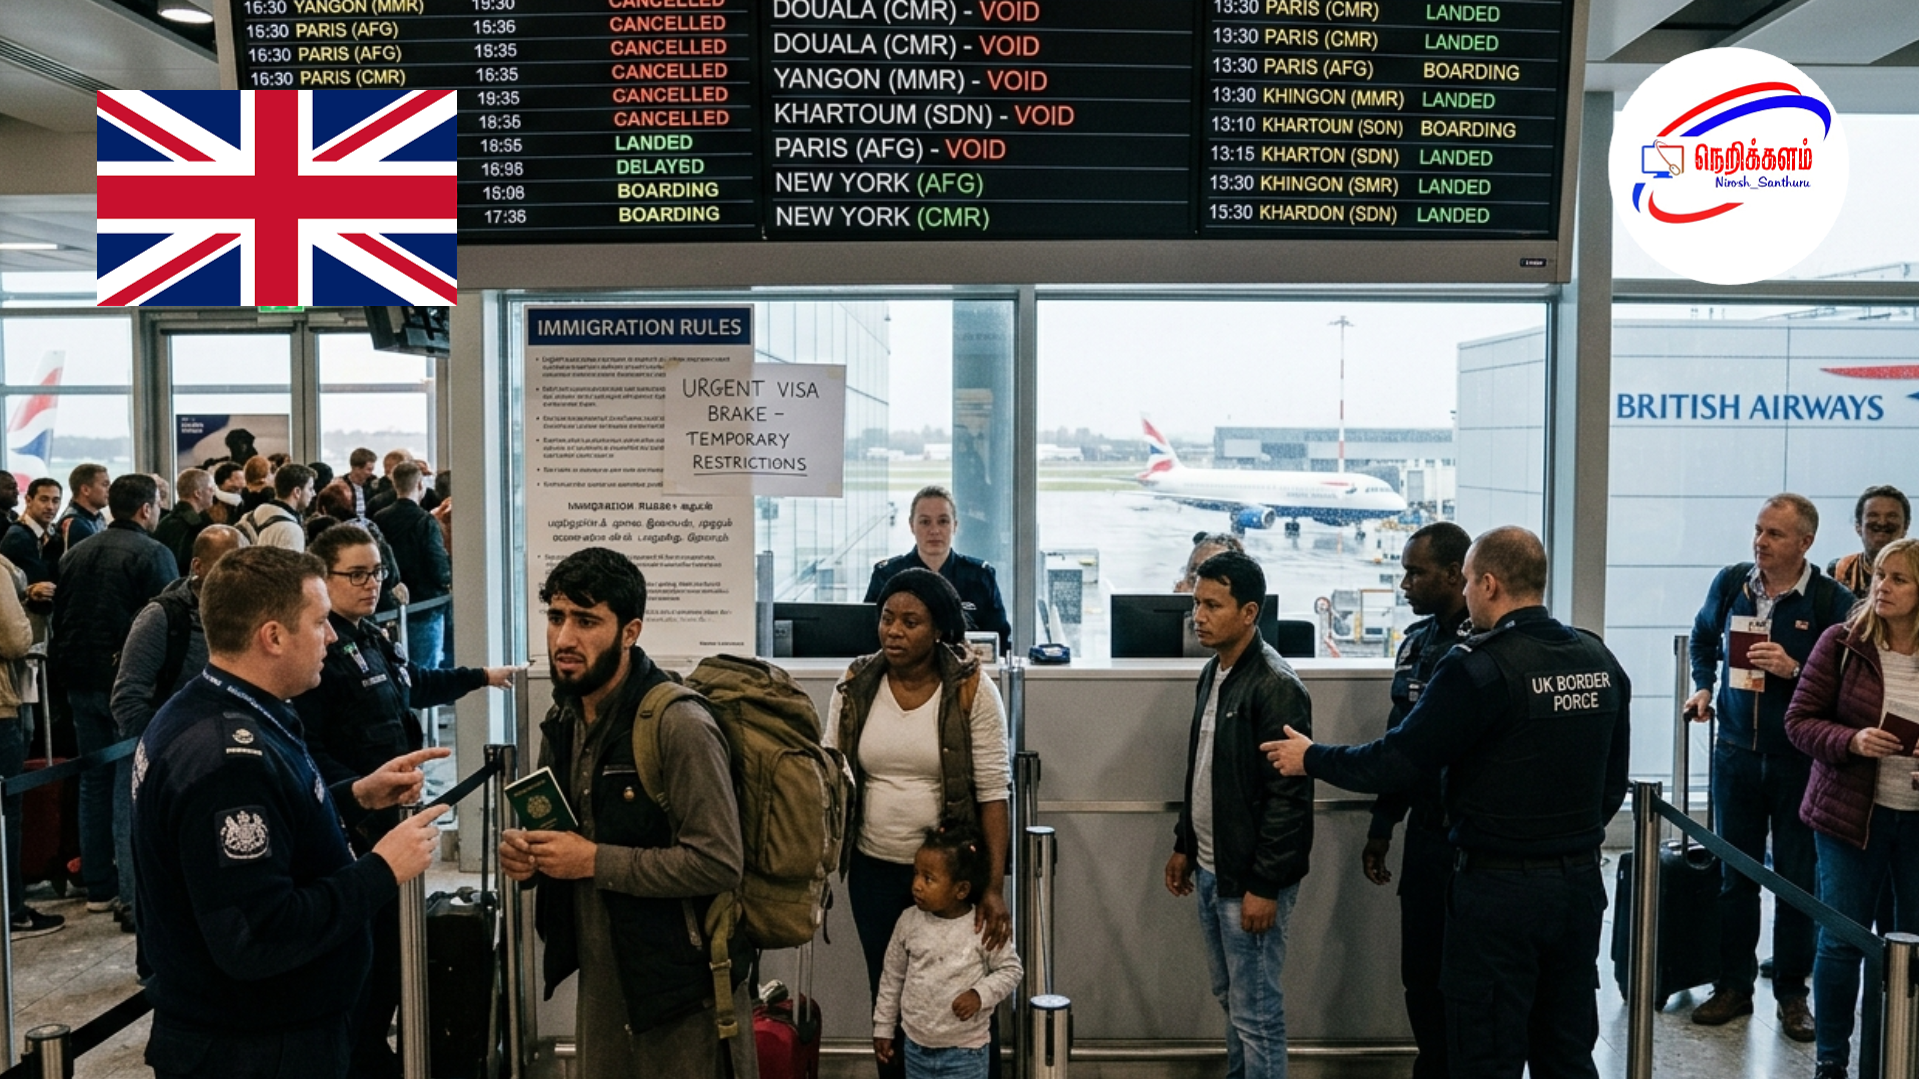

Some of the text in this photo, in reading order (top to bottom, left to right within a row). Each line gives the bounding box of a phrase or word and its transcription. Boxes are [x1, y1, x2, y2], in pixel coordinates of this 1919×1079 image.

[245, 0, 287, 14] 16:30
[294, 0, 366, 13] YANGON
[372, 0, 423, 15] (MMR)
[774, 0, 876, 19] DOUALA
[884, 0, 956, 25] (CMR)
[980, 1, 1039, 21] VOID
[1215, 0, 1500, 22] 13:30 PARIS (CMR) LANDED
[247, 24, 289, 38] 16:30
[296, 23, 347, 37] PARIS
[352, 22, 398, 40] (AFG)
[610, 15, 725, 32] CANCELLED
[774, 33, 877, 54] DOUALA
[884, 34, 956, 59] (CMR)
[980, 36, 1039, 56] VOID
[1214, 28, 1498, 51] 13:30 PARIS (CMR) LANDED
[249, 48, 291, 62] 16:30
[299, 46, 349, 61] PARIS
[355, 45, 401, 63] (AFG)
[611, 39, 726, 55] CANCELLED
[251, 63, 727, 87] 16:30 PARIS (CMR) 16:35 CANCELLED
[1214, 57, 1519, 81] 13:30 PARIS (AFG) BOARDING
[774, 68, 880, 89] YANGON
[889, 69, 964, 94] (MMR)
[987, 70, 1047, 90] VOID
[613, 87, 728, 103] CANCELLED
[1213, 87, 1495, 110] 13:30 KHINGON (MMR) LANDED
[614, 110, 729, 126] CANCELLED
[775, 103, 916, 124] KHARTOUM
[925, 104, 992, 129] (SDN)
[1015, 105, 1074, 125] VOID
[1212, 116, 1255, 132] 13:10
[1421, 121, 1516, 138] BOARDING
[616, 135, 692, 150] LANDED
[776, 138, 847, 158] PARIS
[856, 138, 923, 163] (AFG)
[946, 139, 1005, 159] VOID
[1212, 146, 1492, 167] 13:15 KHARTON (SDN) LANDED
[618, 182, 719, 198] BOARDING
[776, 172, 983, 197] NEW YORK (AFG)
[1211, 175, 1491, 196] 13:30 KHINGON (SMR) LANDED
[619, 206, 719, 222] BOARDING
[777, 206, 989, 230] NEW YORK (CMR)
[1210, 204, 1489, 225] 15:30 KHARDON (SDN) LANDED
[539, 319, 740, 335] IMMIGRATION RULES
[683, 378, 765, 398] URGENT
[777, 381, 820, 399] VISA
[708, 405, 767, 422] BRAKE
[1617, 394, 1884, 421] BRITISH AIRWAYS
[686, 431, 790, 449] TEMPORARY
[693, 454, 807, 472] RESTRICTIONS
[1531, 672, 1611, 694] UK BORDER
[1553, 692, 1599, 712] PORCE
